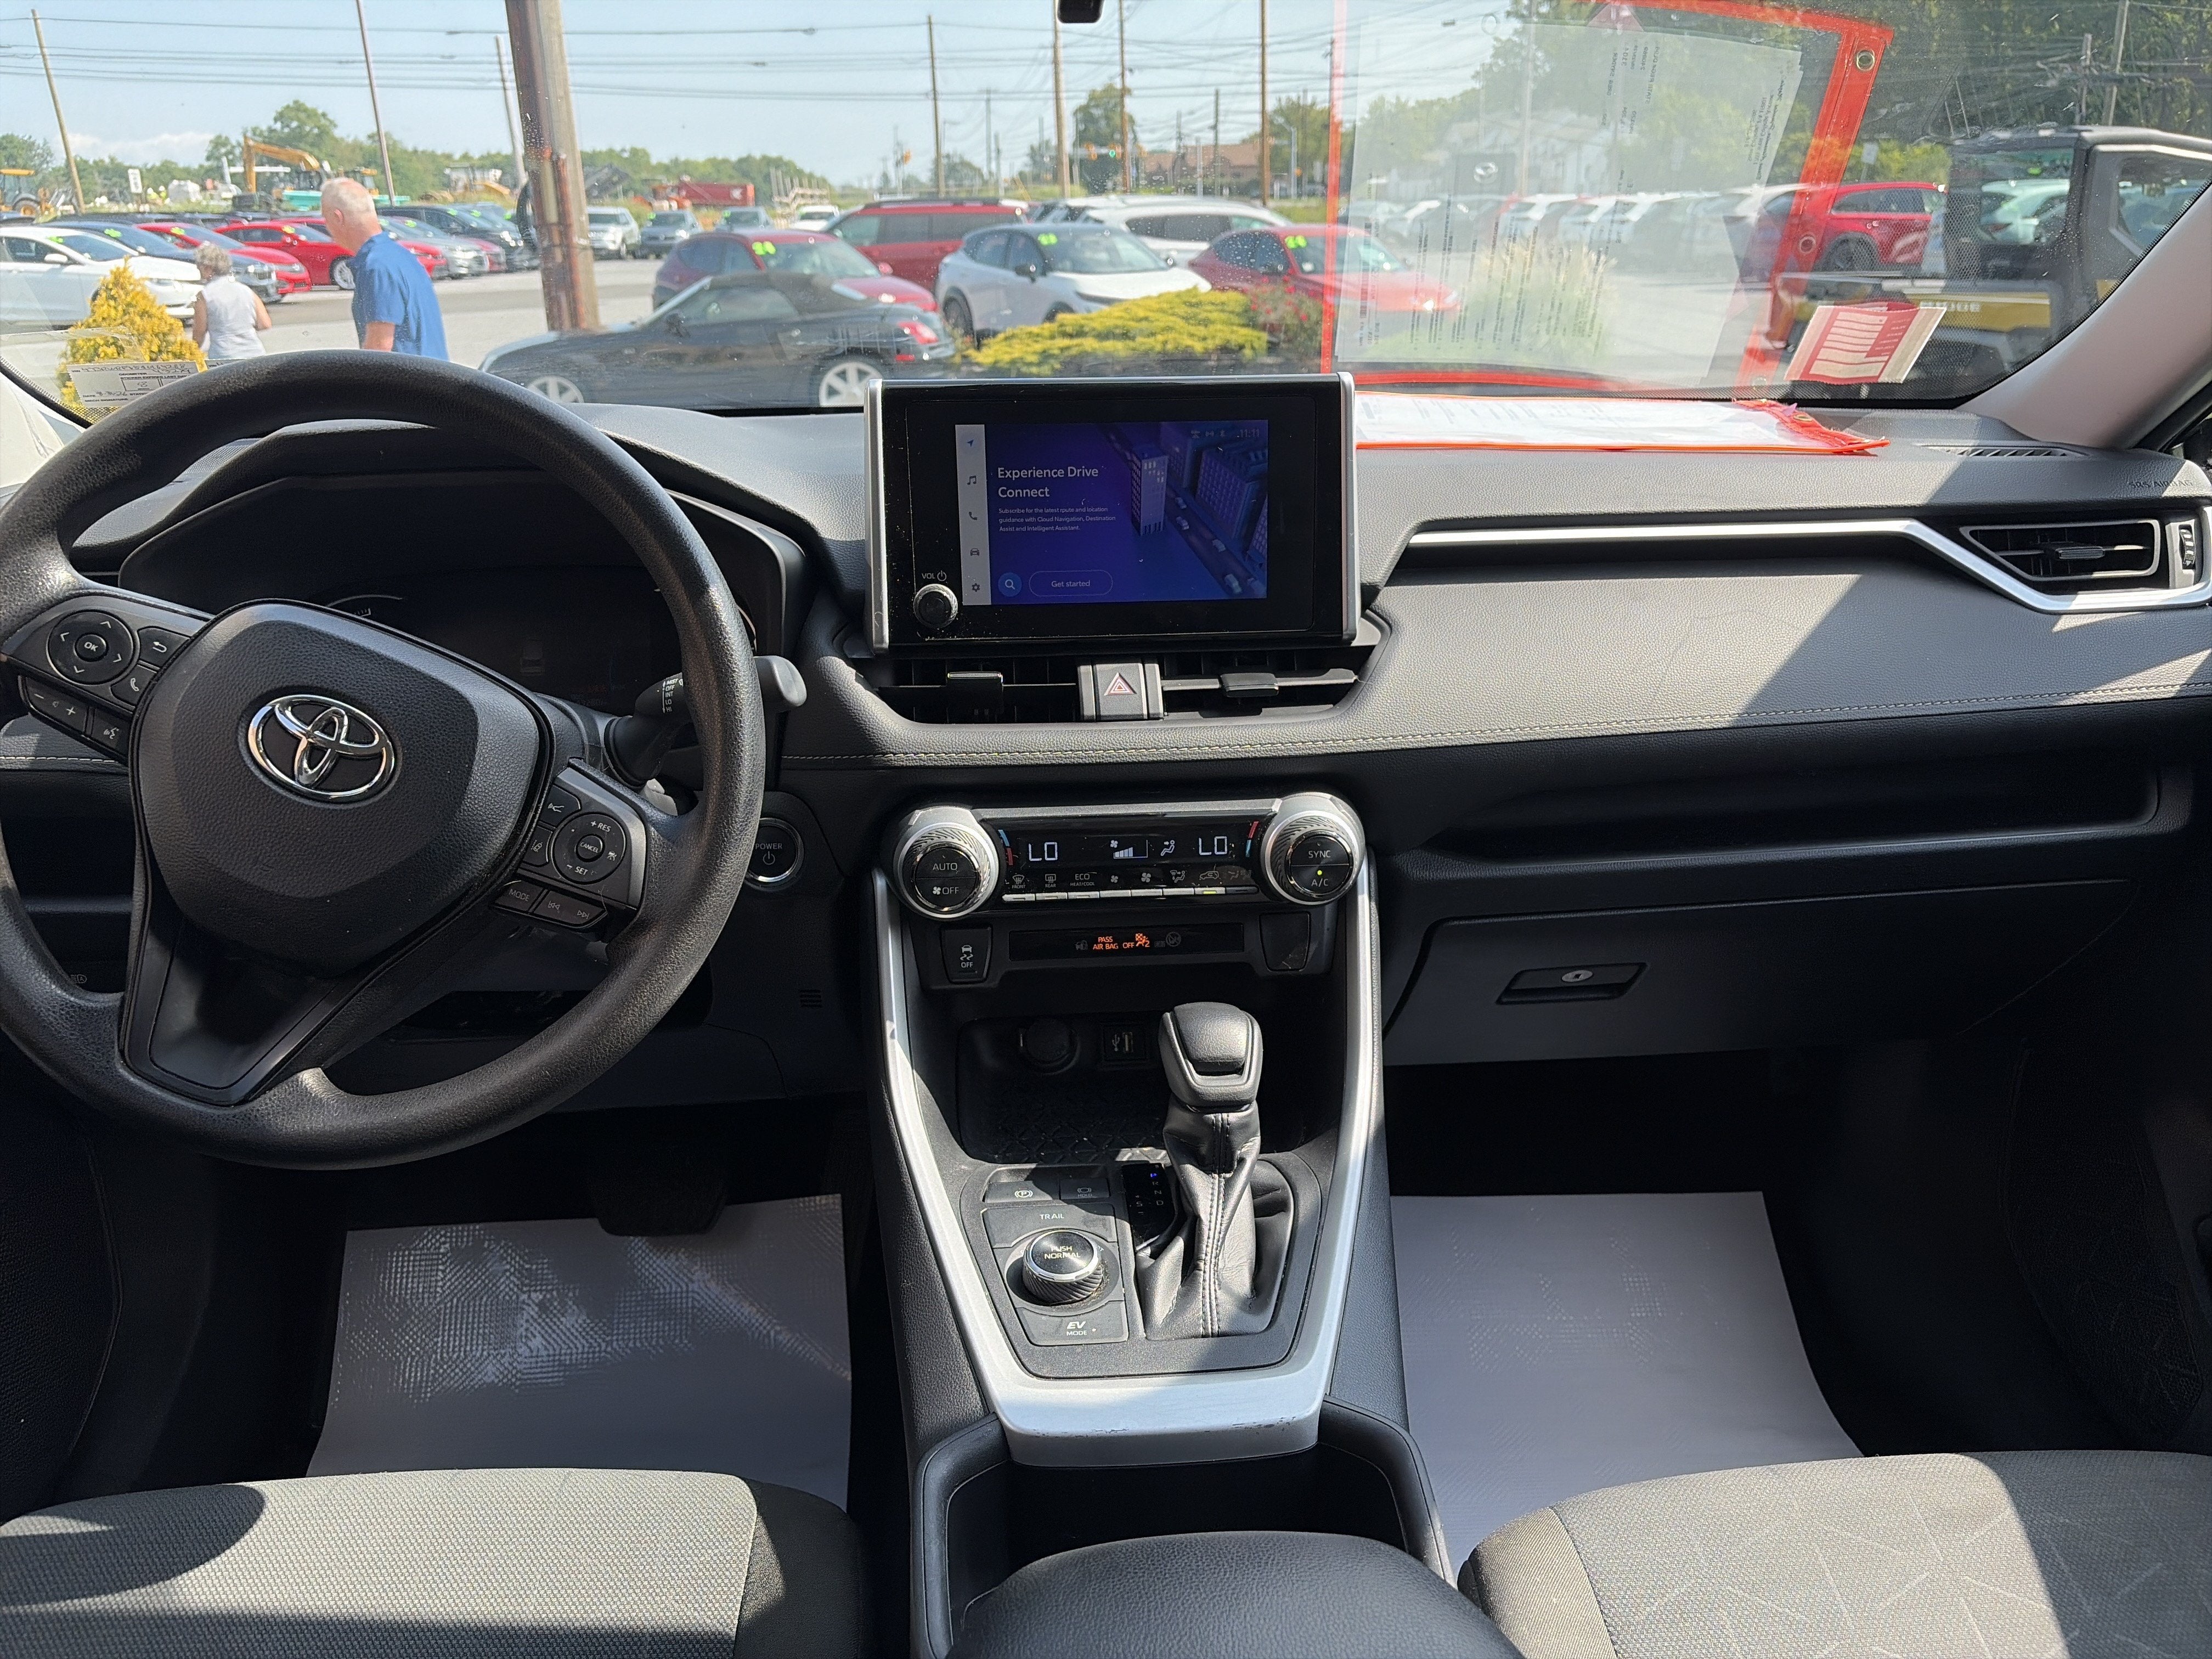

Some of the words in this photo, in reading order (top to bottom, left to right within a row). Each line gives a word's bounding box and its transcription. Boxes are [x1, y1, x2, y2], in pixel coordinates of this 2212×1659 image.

[1240, 429, 1260, 438] 11:11
[997, 466, 1065, 481] Experience
[1067, 466, 1099, 477] Drive
[997, 486, 1050, 498] Connect
[1051, 579, 1065, 588] Get
[1066, 579, 1090, 588] started
[84, 641, 99, 652] OK
[597, 822, 612, 832] RES
[580, 842, 599, 853] CANCEL
[755, 842, 783, 850] POWER
[1198, 836, 1228, 855] LO
[1028, 842, 1058, 861] LO
[1308, 850, 1331, 859] SYNC
[574, 866, 589, 876] SET
[932, 862, 958, 871] AUTO
[1311, 878, 1329, 887] A/C
[509, 889, 530, 902] MODE
[942, 887, 960, 895] OFF
[1066, 1321, 1086, 1329] EV
